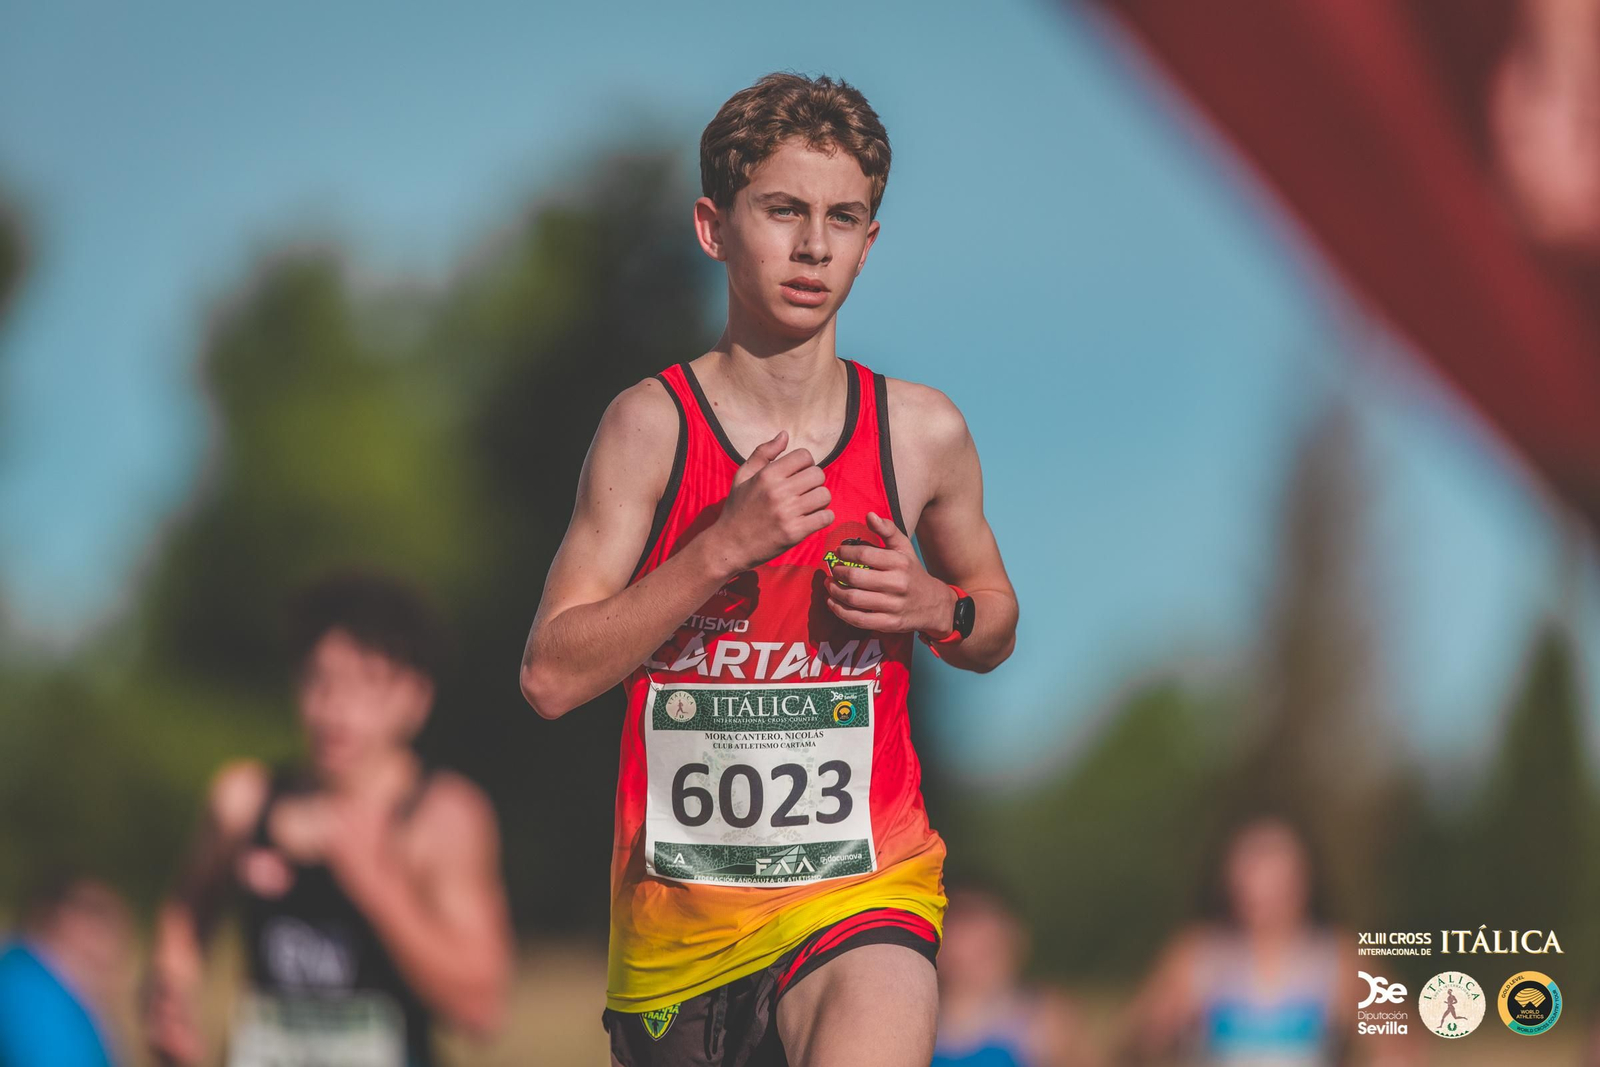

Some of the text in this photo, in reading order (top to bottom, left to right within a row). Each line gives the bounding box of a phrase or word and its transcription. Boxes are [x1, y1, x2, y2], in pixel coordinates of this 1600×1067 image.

[712, 691, 818, 717] ITÁLICA
[705, 729, 824, 742] MORA CANTERO, NICOLÁS
[713, 741, 816, 750] CLUB ATLETISMO CARTAMA
[671, 760, 853, 828] 6023
[827, 853, 863, 863] docunova
[694, 875, 735, 883] FEDERACIÓN
[738, 876, 775, 884] ANDALUZA
[788, 875, 822, 883] ATLETISMO
